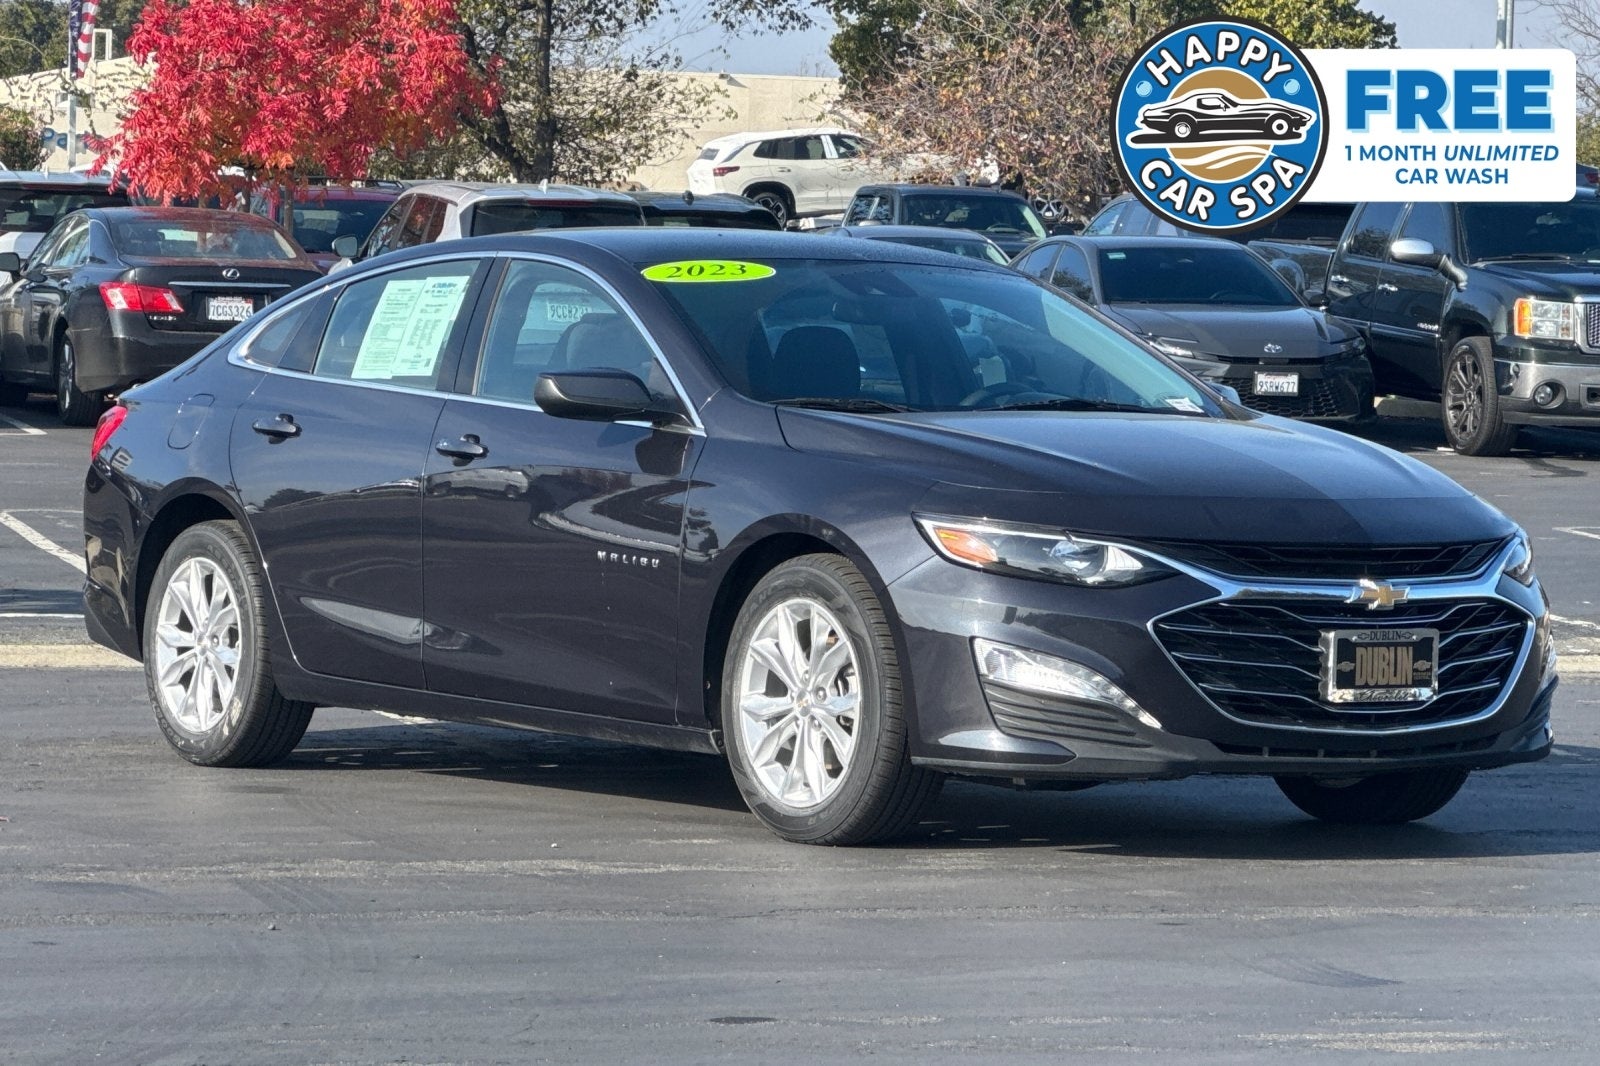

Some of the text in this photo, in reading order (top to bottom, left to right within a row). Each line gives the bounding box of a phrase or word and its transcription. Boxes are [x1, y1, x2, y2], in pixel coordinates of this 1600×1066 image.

[665, 264, 747, 279] 2023
[597, 550, 660, 568] MALIBU
[1369, 630, 1402, 641] DUBLIN
[1355, 645, 1414, 687] DUBLIN
